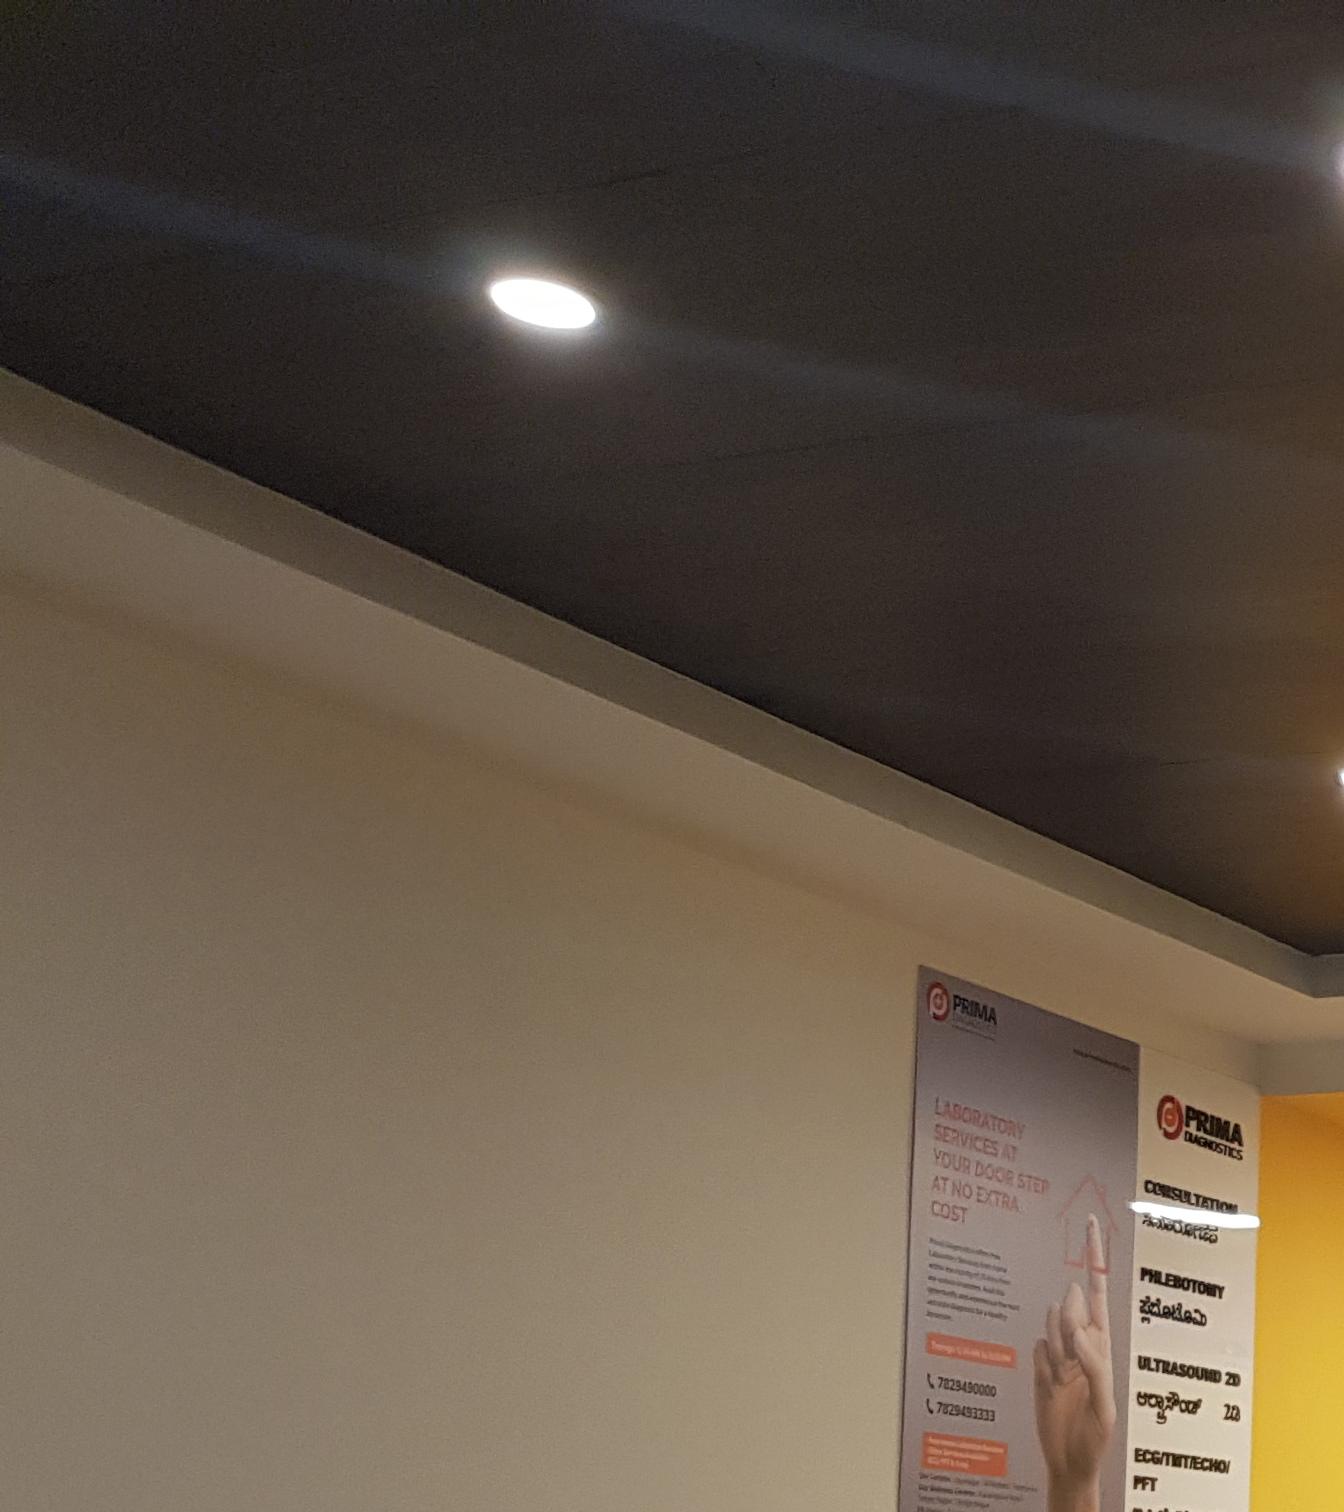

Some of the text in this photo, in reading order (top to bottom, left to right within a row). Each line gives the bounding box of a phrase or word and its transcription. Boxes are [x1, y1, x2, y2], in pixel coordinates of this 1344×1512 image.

[952, 994, 998, 1026] PRIMA
[935, 1096, 1026, 1139] LABORATORY
[1184, 1104, 1245, 1147] PRIMA
[935, 1123, 999, 1157] SERVICES
[1184, 1130, 1244, 1162] DIAGNOSTICS
[933, 1147, 971, 1175] YOUR
[975, 1161, 1014, 1186] DOOR
[931, 1175, 949, 1194] AT
[951, 1181, 973, 1200] NO
[1143, 1179, 1239, 1214] CONSULTATION
[931, 1200, 968, 1223] COST
[1140, 1266, 1226, 1299] PHLEBOTOMY
[1137, 1355, 1241, 1387] ULTRASOUND 2D
[1133, 1448, 1231, 1475] ECG/TMT/ECHO/
[1133, 1475, 1158, 1492] PFT
